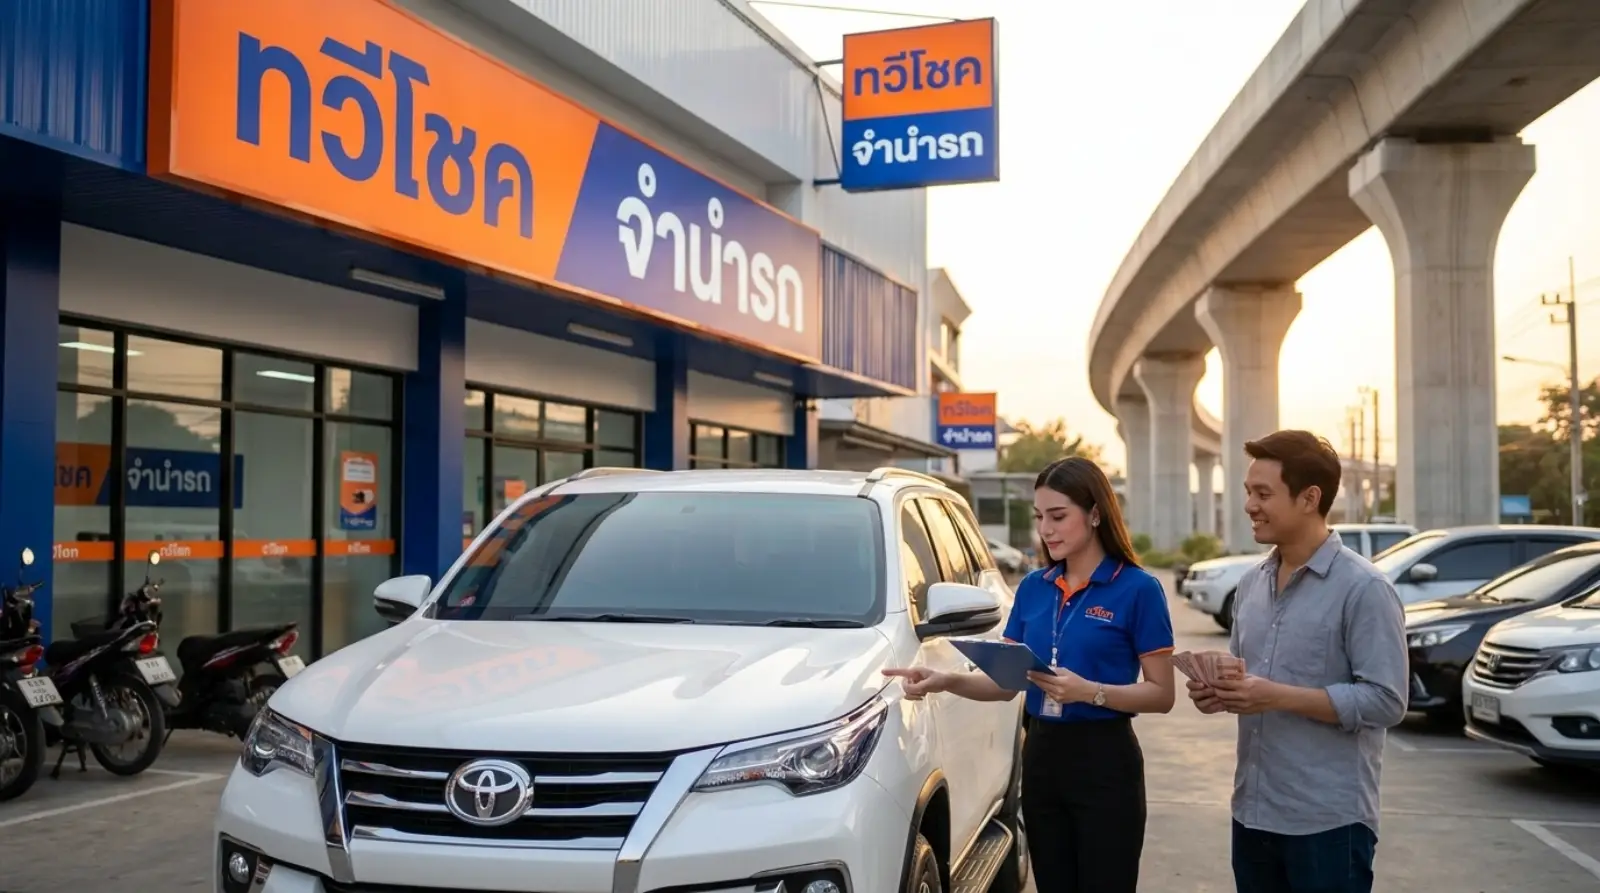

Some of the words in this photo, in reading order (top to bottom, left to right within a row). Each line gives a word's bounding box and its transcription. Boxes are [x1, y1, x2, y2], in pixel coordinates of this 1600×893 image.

[853, 49, 983, 97] ทวีโชค
[852, 124, 984, 166] จำนำรถ
[236, 31, 534, 240] ทวีโชค
[616, 162, 804, 333] จำนำรถ
[127, 457, 212, 492] จำนำรถ
